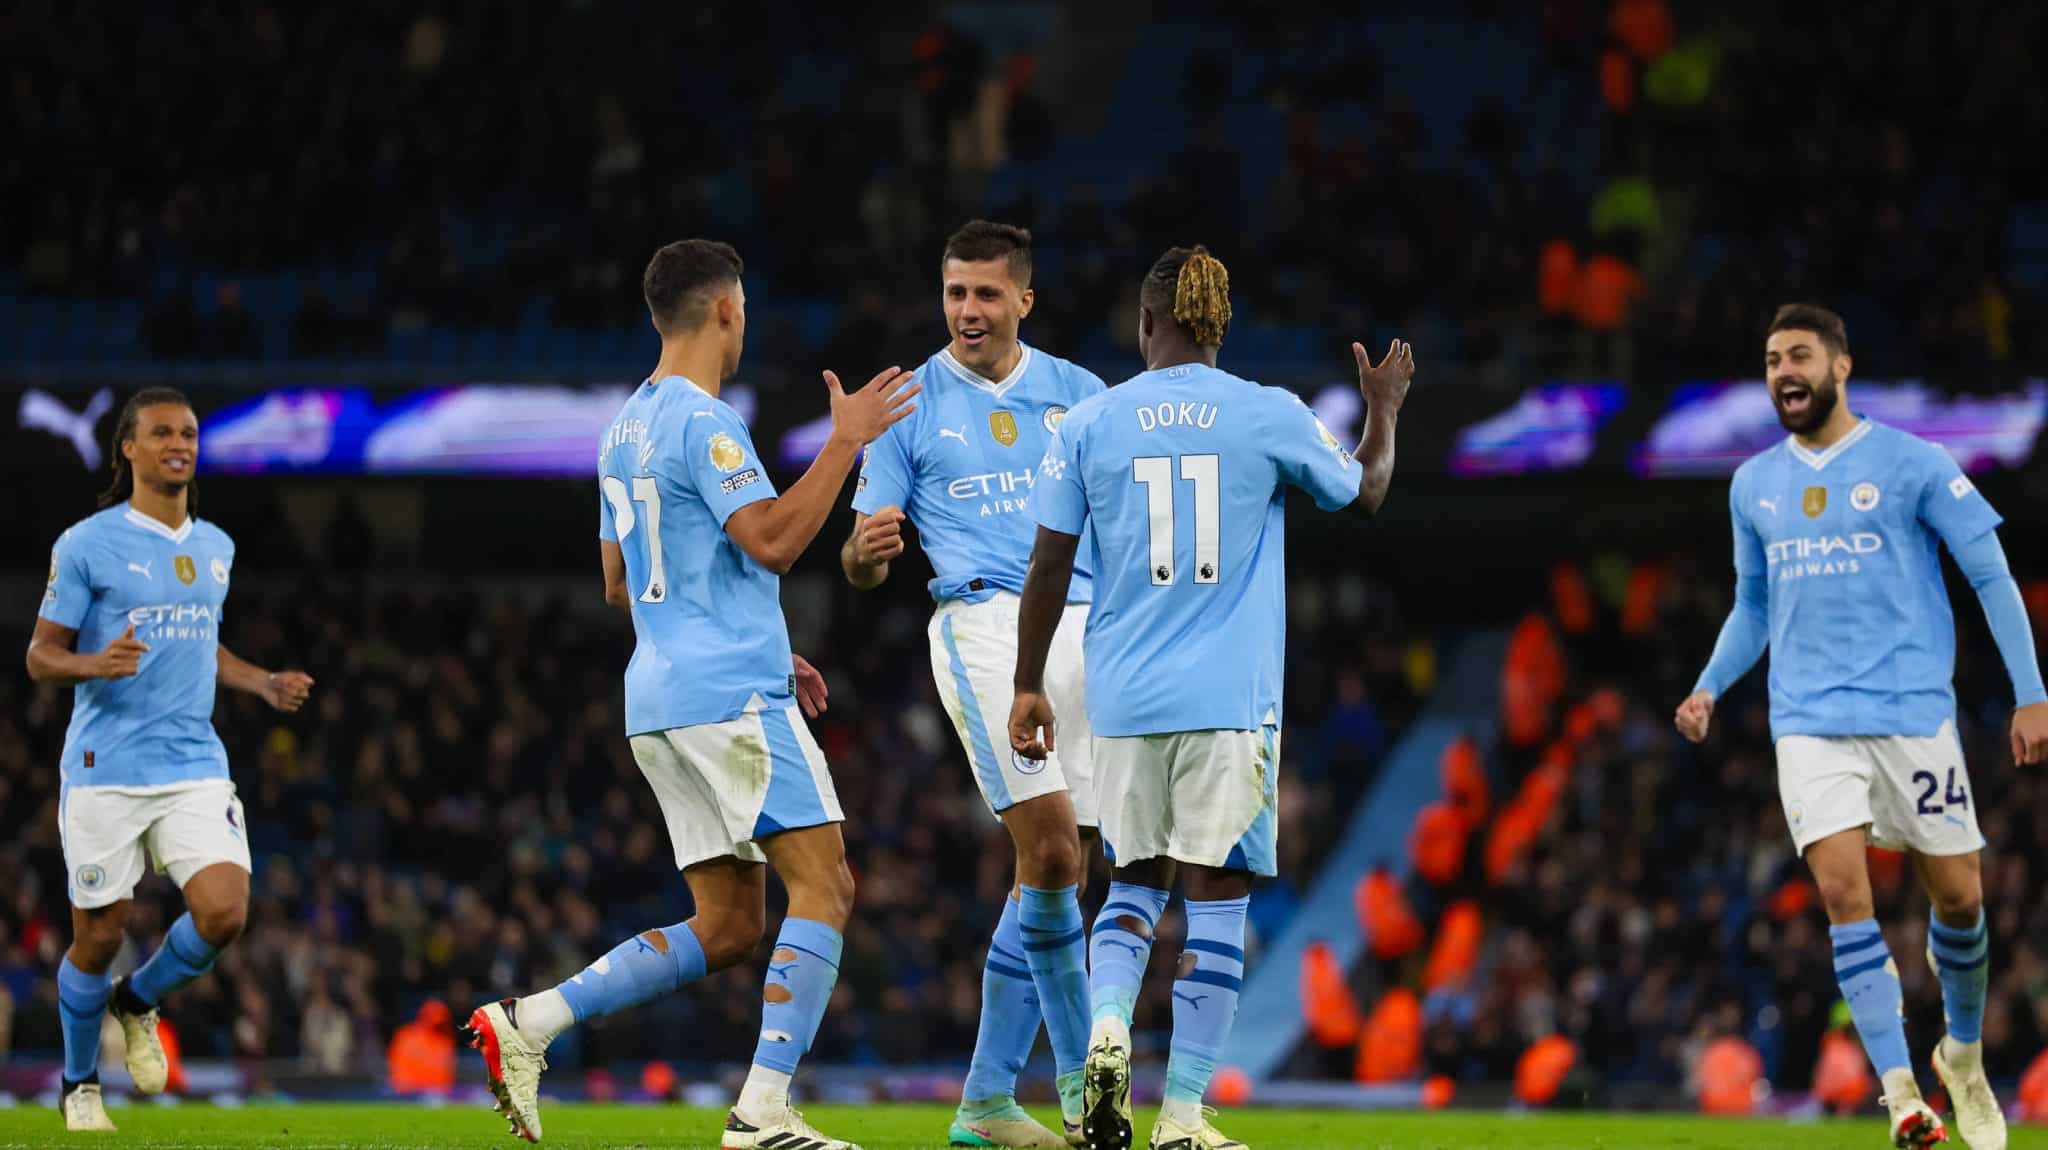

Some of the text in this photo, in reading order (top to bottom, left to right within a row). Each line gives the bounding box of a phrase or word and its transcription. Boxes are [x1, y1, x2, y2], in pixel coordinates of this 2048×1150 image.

[1168, 367, 1192, 377] CITY
[1136, 402, 1218, 432] DOKU
[732, 469, 755, 483] room
[948, 468, 1037, 499] ETIH
[1133, 453, 1220, 586] 11
[1766, 533, 1882, 564] ETIHAD
[1780, 559, 1860, 578] AIRWAYS
[128, 603, 220, 625] ETIHA
[1912, 766, 1969, 815] 24
